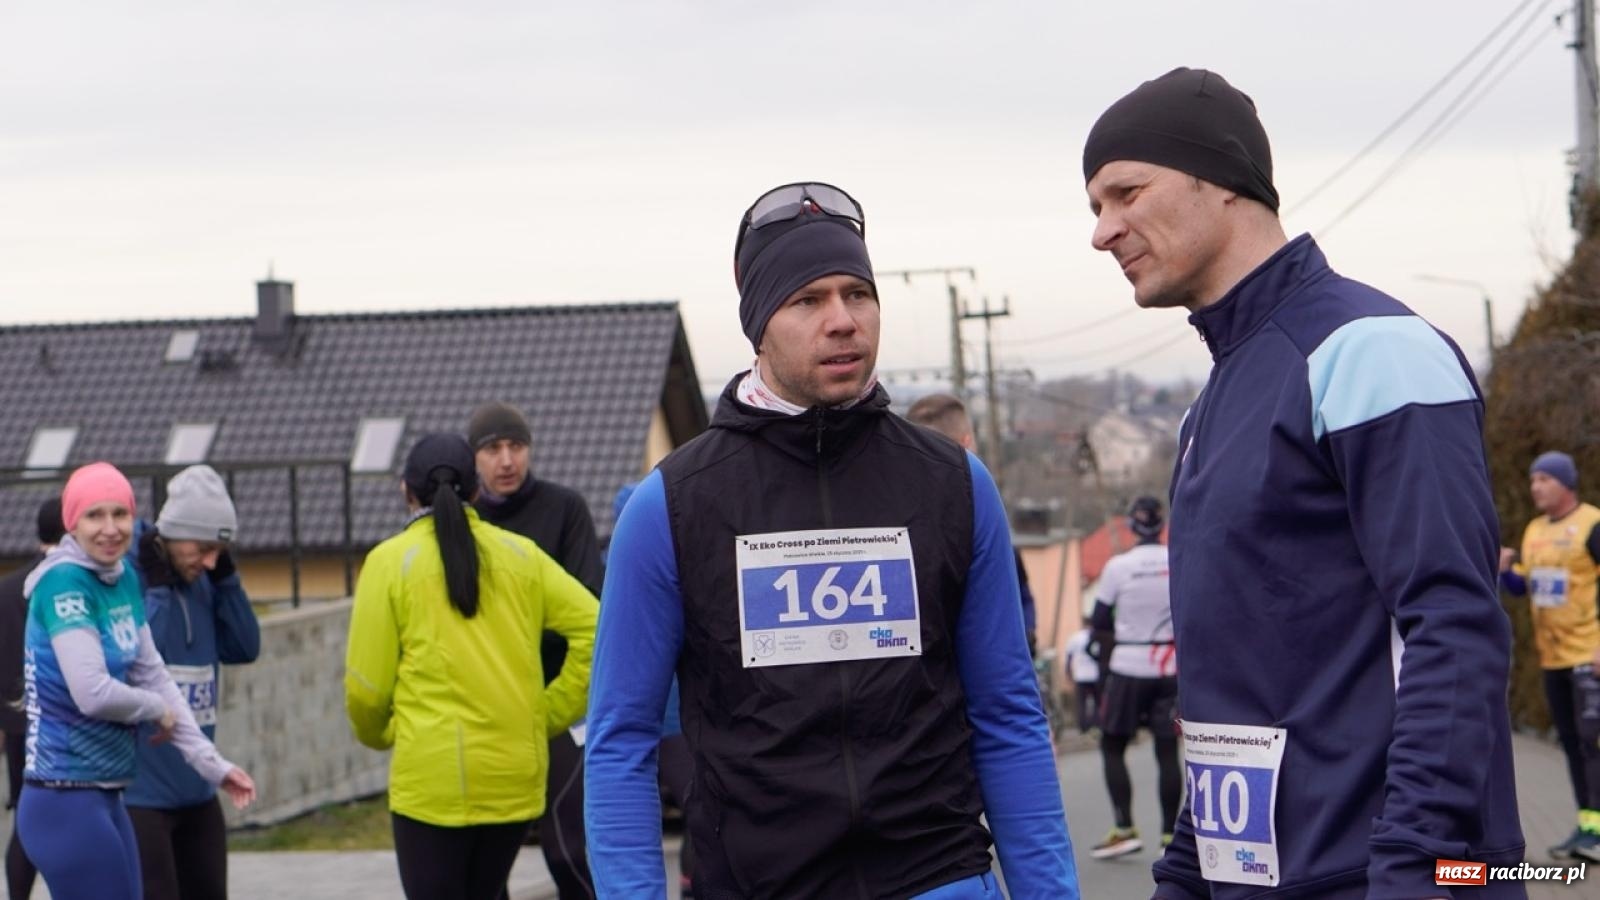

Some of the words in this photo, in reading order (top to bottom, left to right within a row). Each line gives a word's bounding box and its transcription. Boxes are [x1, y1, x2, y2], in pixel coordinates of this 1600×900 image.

[749, 543, 759, 551] IX
[760, 541, 776, 550] Eko
[777, 539, 802, 548] Cross
[804, 539, 816, 549] po
[817, 536, 841, 546] Ziemi
[842, 534, 899, 545] Pietrowickiej
[773, 564, 888, 622] 164
[1199, 733, 1218, 744] Ziemi
[1218, 734, 1272, 750] Pietrowickiej
